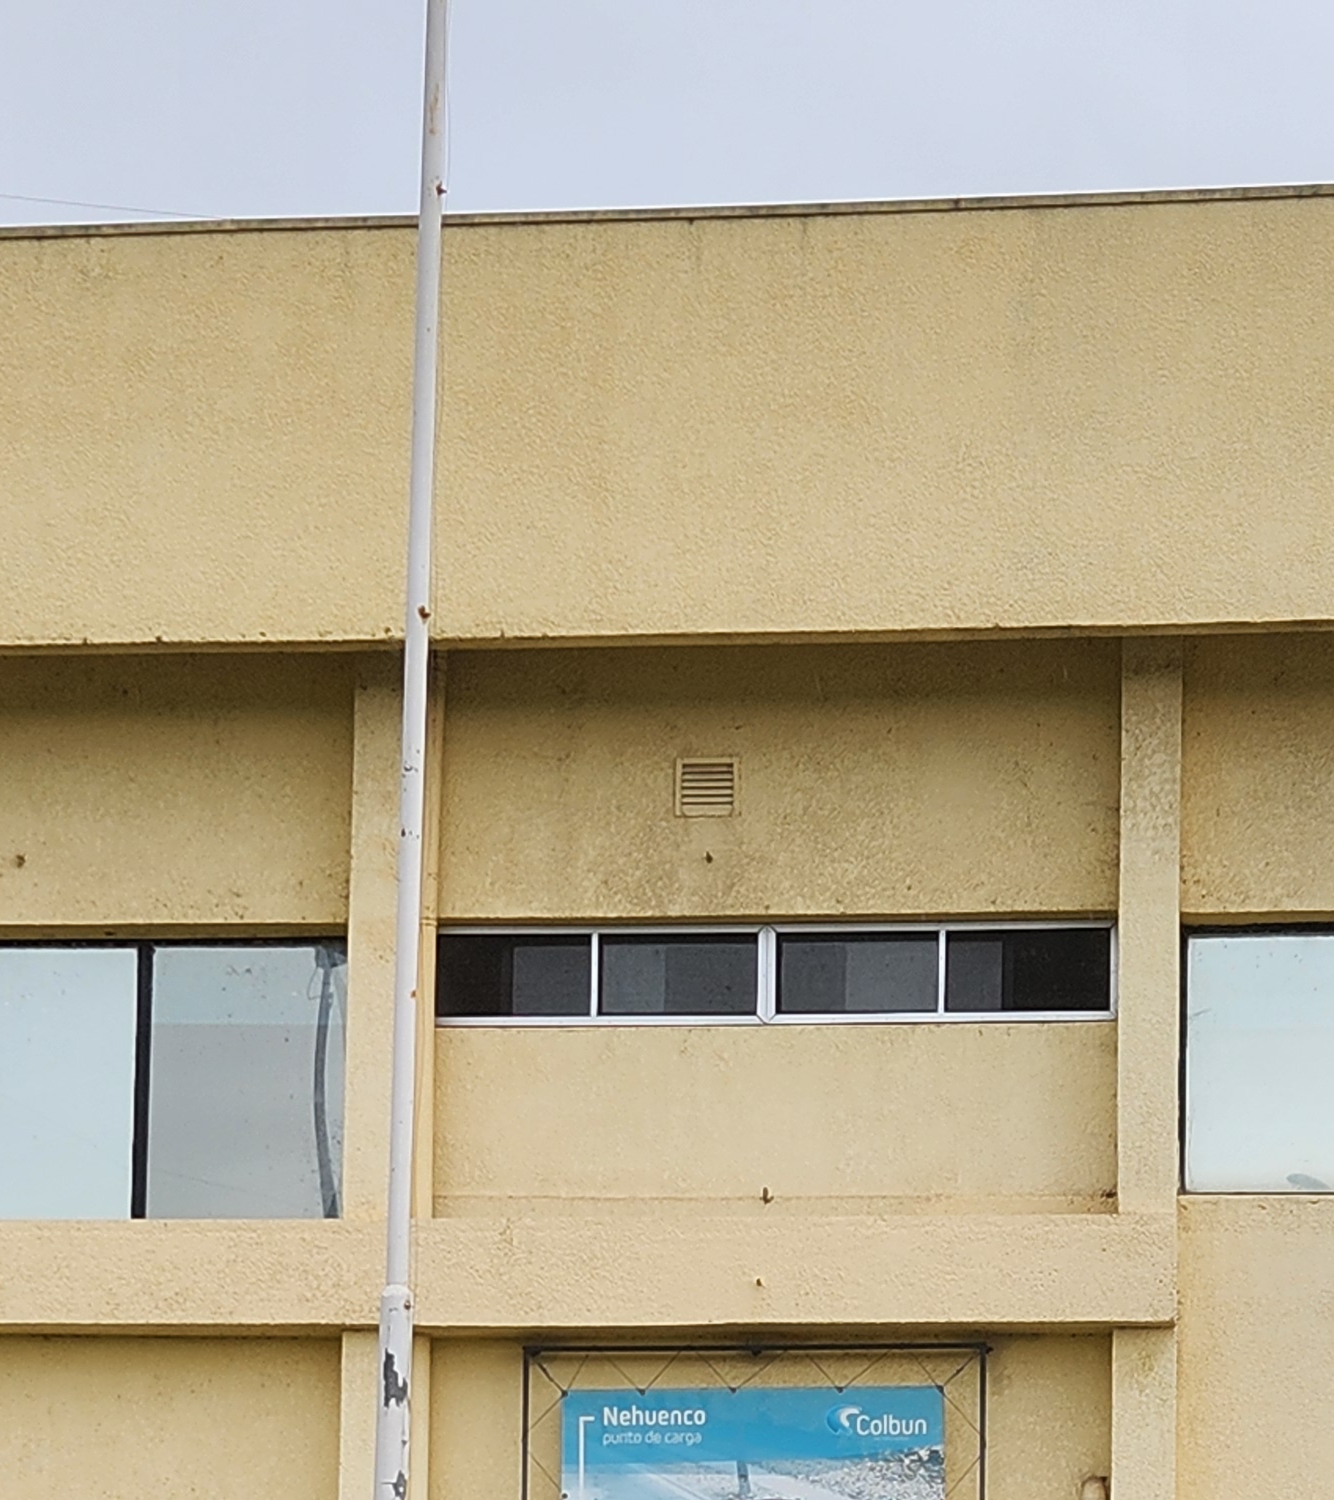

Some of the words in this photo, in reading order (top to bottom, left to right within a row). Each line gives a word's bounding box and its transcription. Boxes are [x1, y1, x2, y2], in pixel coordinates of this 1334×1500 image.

[603, 1404, 706, 1427] Nehuenco
[856, 1414, 927, 1435] Colbun
[602, 1430, 642, 1446] punto
[644, 1430, 662, 1444] de
[664, 1432, 702, 1446] carga
